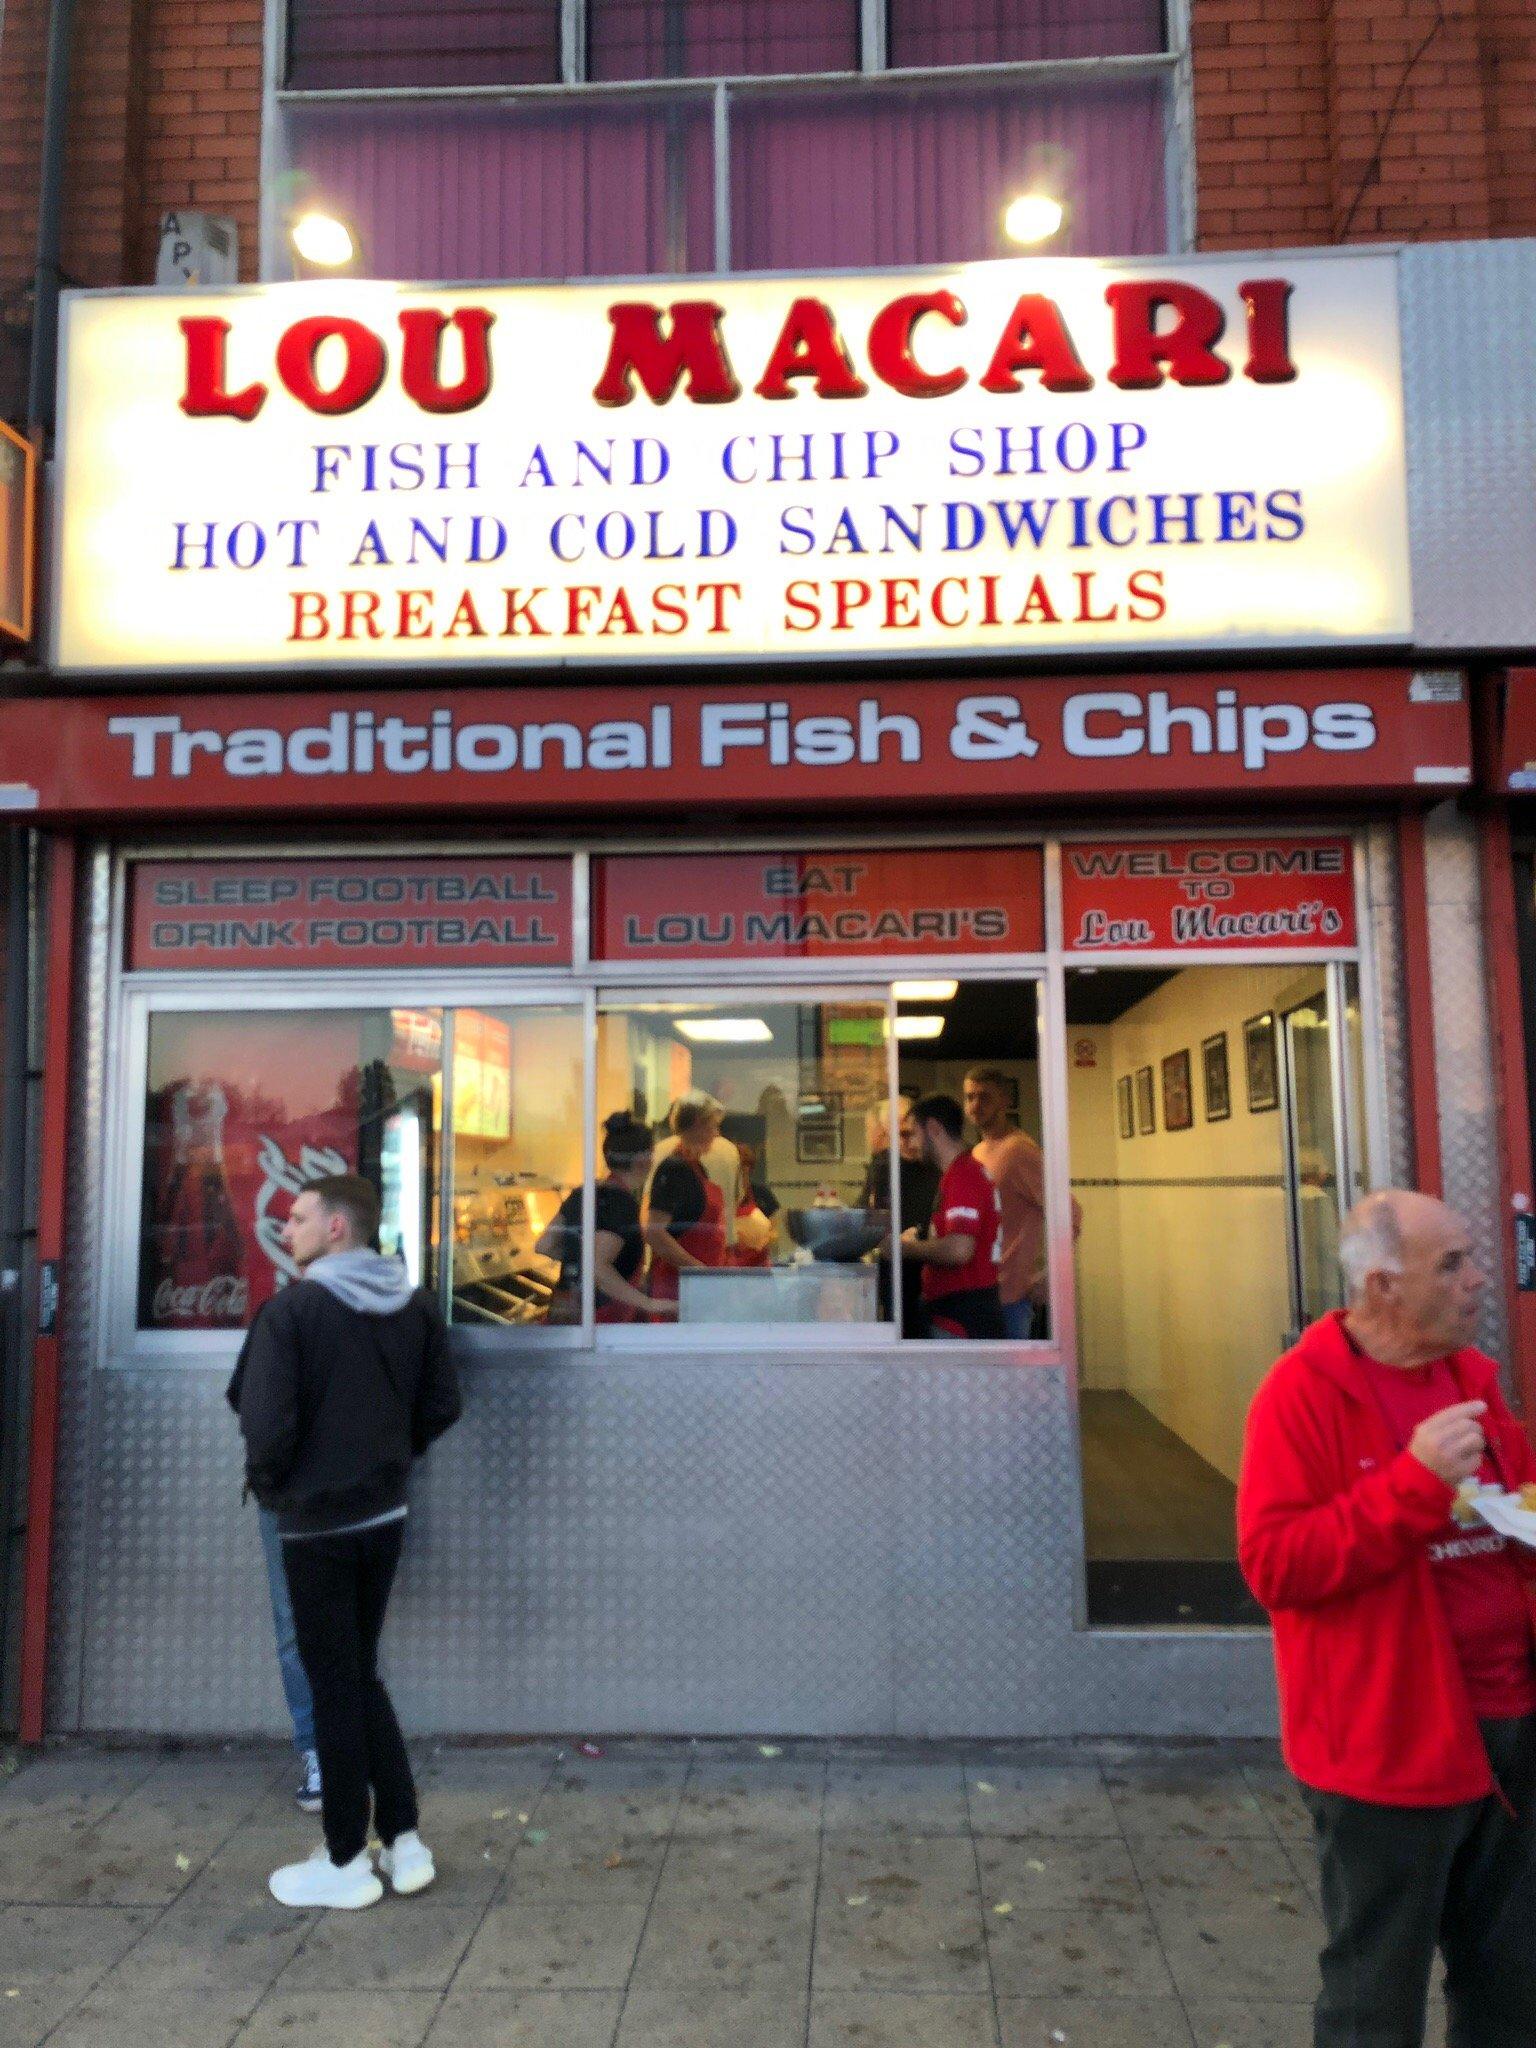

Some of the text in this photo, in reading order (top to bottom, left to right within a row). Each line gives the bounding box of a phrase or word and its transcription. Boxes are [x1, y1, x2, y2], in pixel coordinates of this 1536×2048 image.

[180, 277, 1299, 422] LOU MACARI
[313, 422, 1148, 493] FISH AND CHIP SHOP
[170, 489, 1306, 570] HOT AND COLD SANDWICHES
[288, 570, 1167, 641] BREAKFAST SPECIALS
[109, 690, 1376, 777] Traditional Fish & Chips
[764, 866, 866, 896] EAT
[1073, 849, 1344, 877] WELCOME
[154, 875, 556, 905] SLEEP FOOTBALL
[1181, 880, 1234, 899] TO
[152, 918, 557, 948] DRINK FOOTBALL
[625, 907, 1009, 946] LOU MACARI'S
[1075, 901, 1342, 947] Lou Macari's
